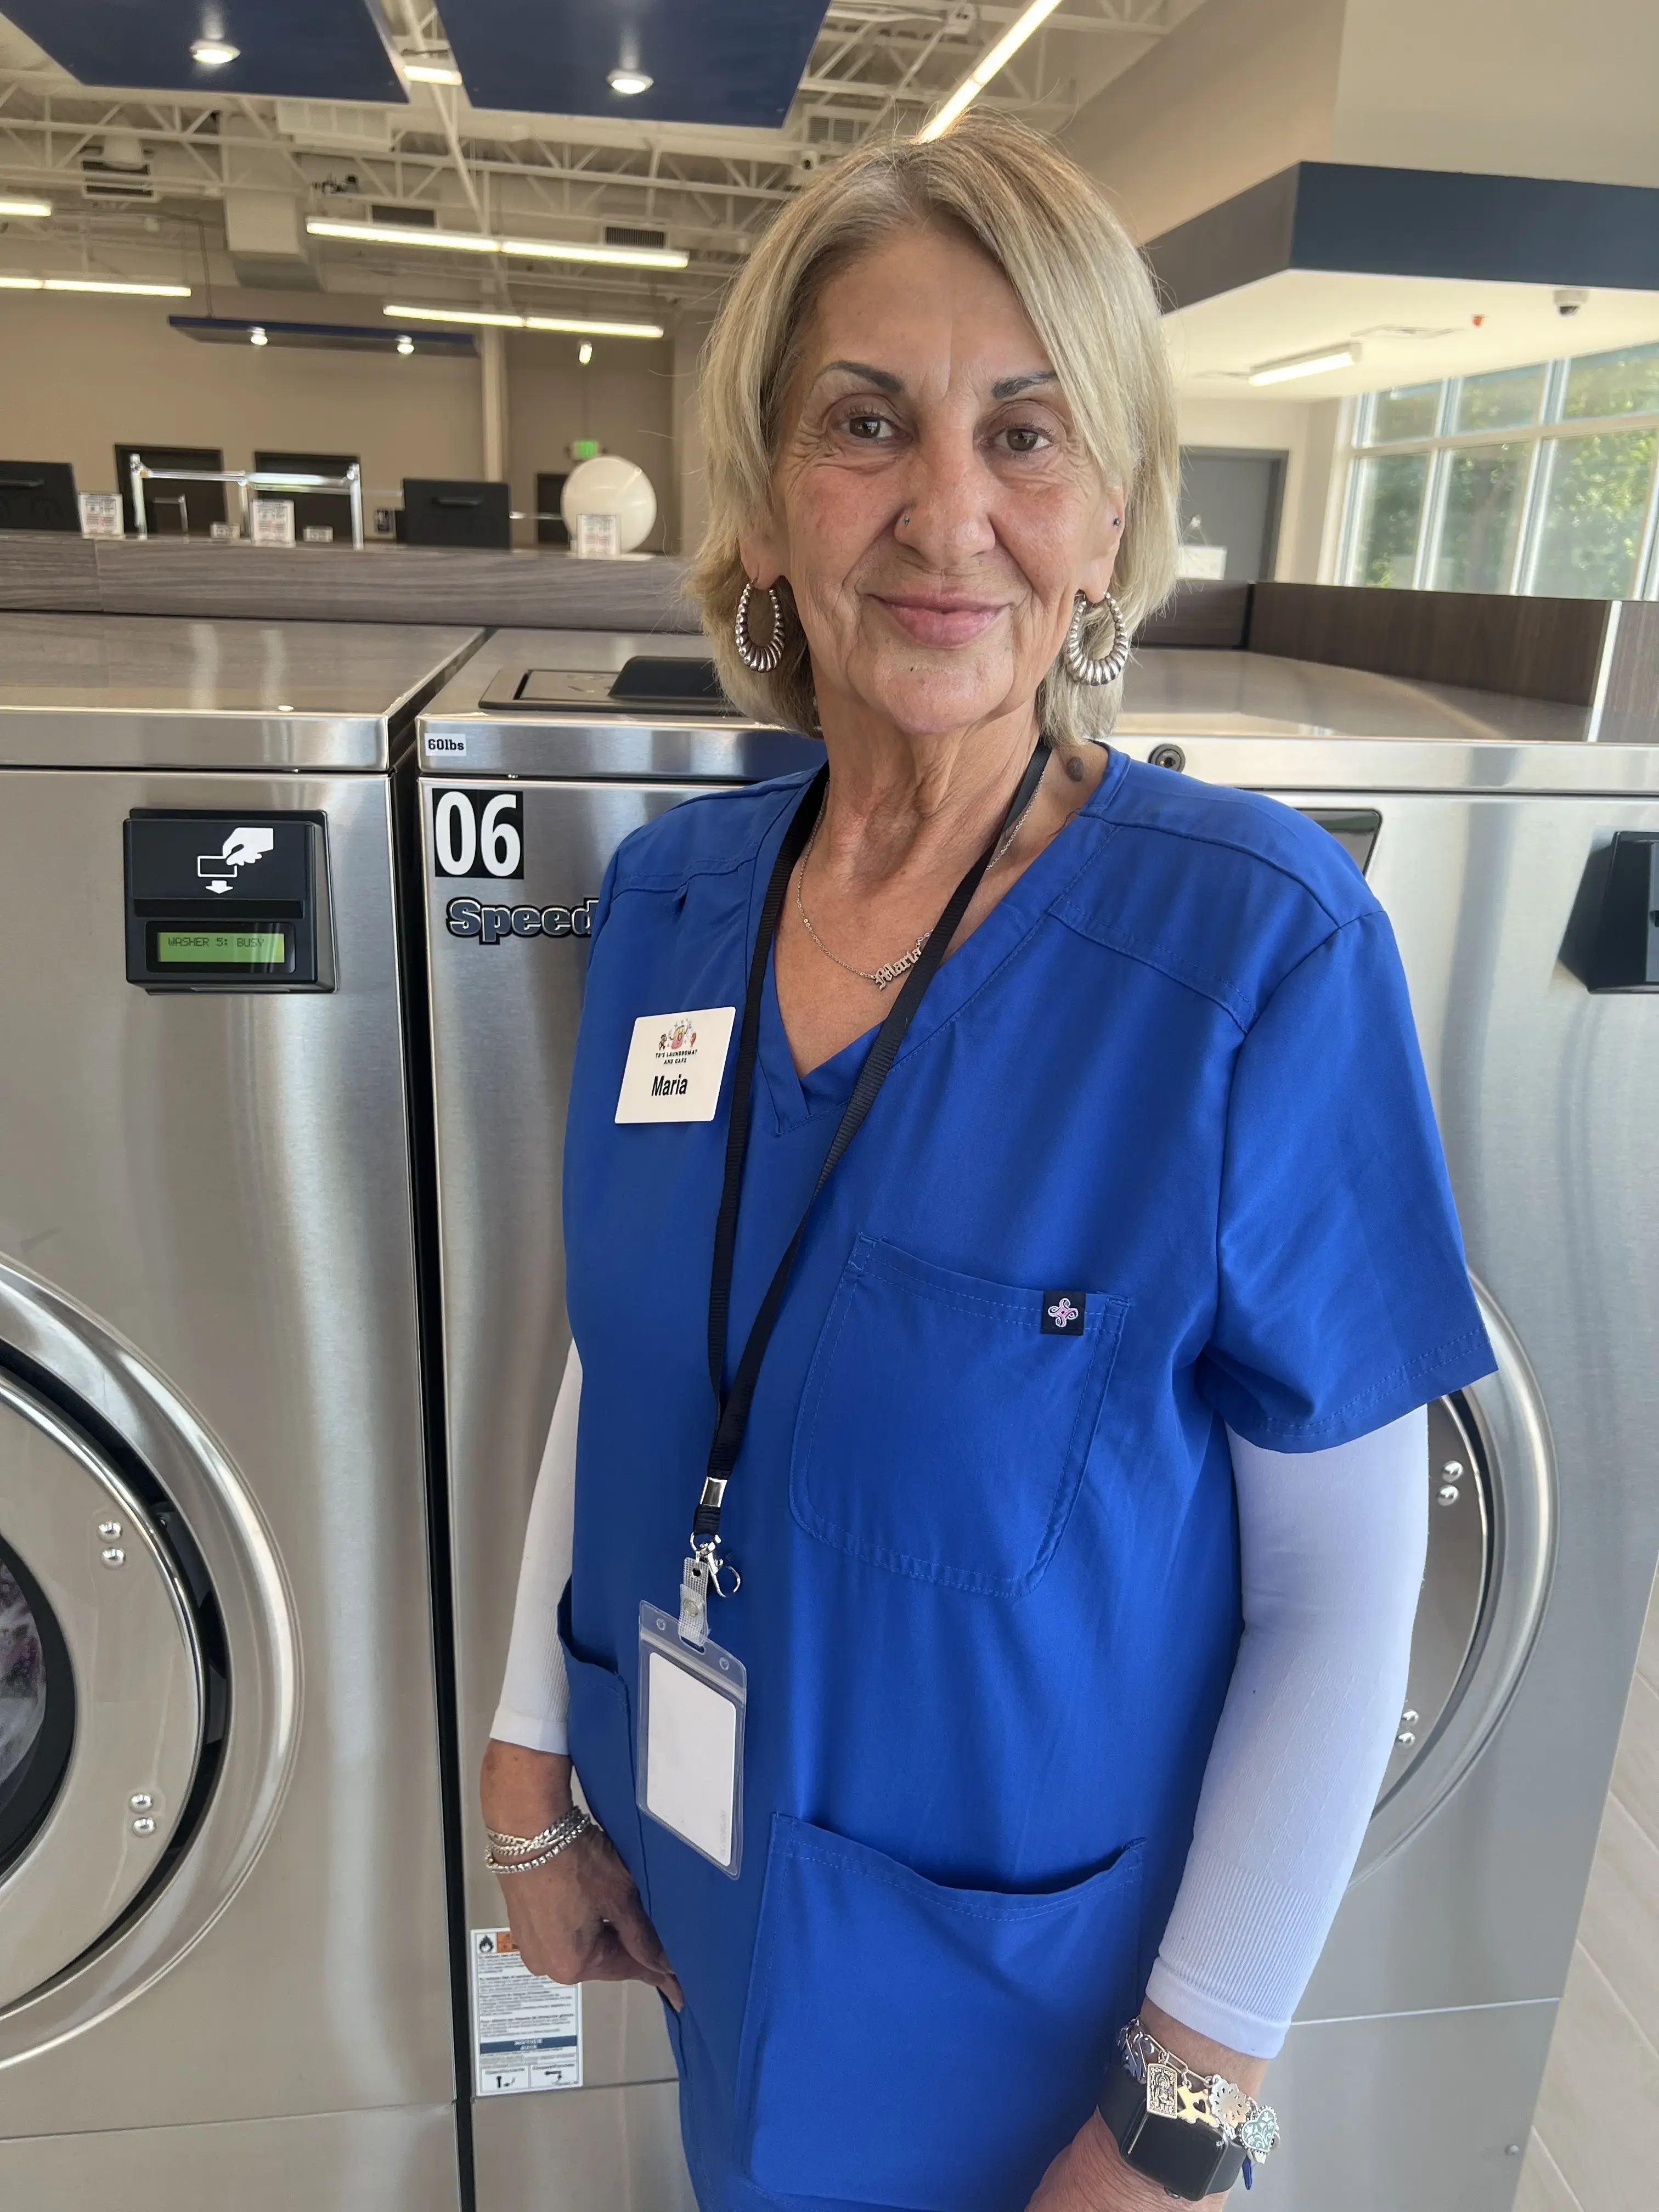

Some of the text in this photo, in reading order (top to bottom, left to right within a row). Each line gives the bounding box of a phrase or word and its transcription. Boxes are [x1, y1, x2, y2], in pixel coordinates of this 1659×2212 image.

[428, 738, 465, 751] 60lbs
[435, 791, 521, 877] 06
[446, 896, 600, 945] Speed
[167, 937, 210, 947] WASHER
[236, 938, 264, 947] BUSY
[667, 1049, 698, 1057] LAUNDROMAT
[651, 1074, 688, 1096] Maria
